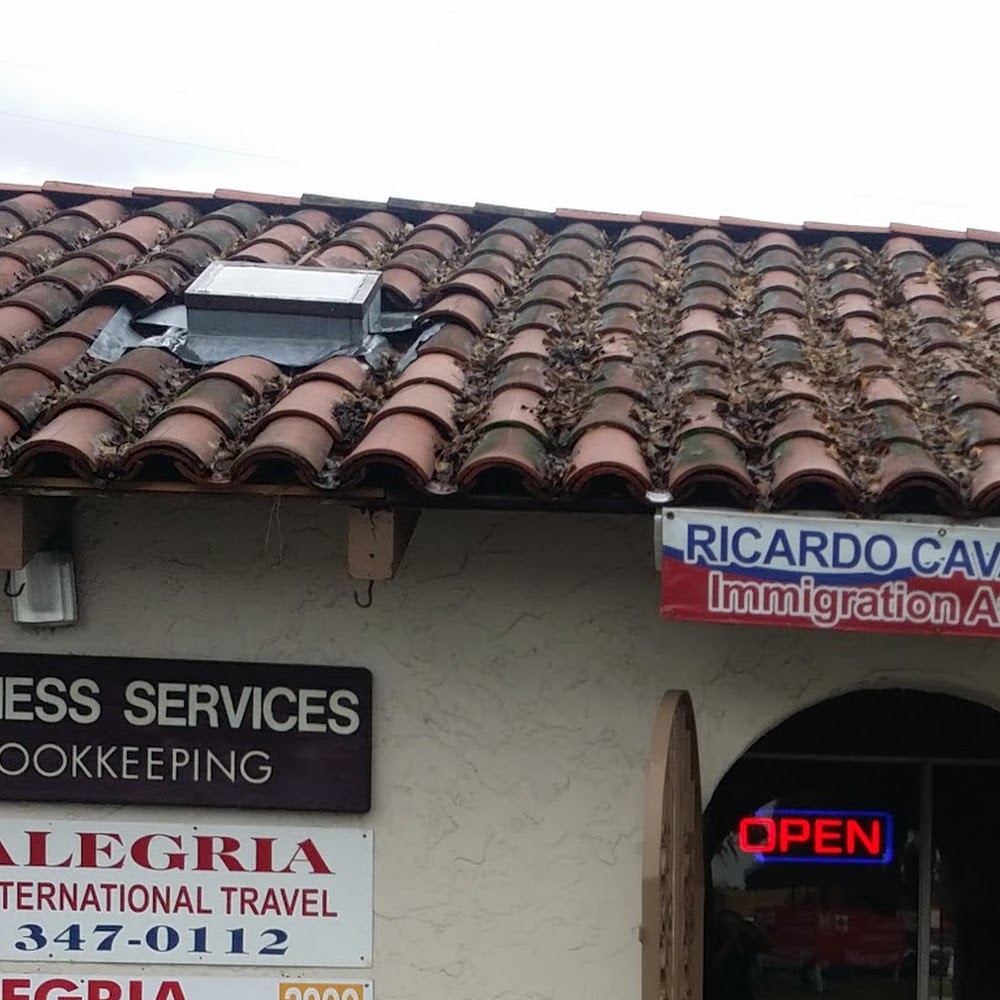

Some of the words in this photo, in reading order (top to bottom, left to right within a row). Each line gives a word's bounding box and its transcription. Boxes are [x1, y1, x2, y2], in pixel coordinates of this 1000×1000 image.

[686, 523, 898, 571] RICARDO
[708, 571, 960, 627] Immigration
[0, 676, 101, 724] ESS
[124, 680, 360, 735] SERVICES
[0, 742, 273, 784] OOKKEEPING
[738, 817, 881, 855] OPEN
[0, 881, 212, 915] TERNATIONAL
[220, 886, 338, 918] TRAVEL
[15, 923, 289, 956] 347-0112
